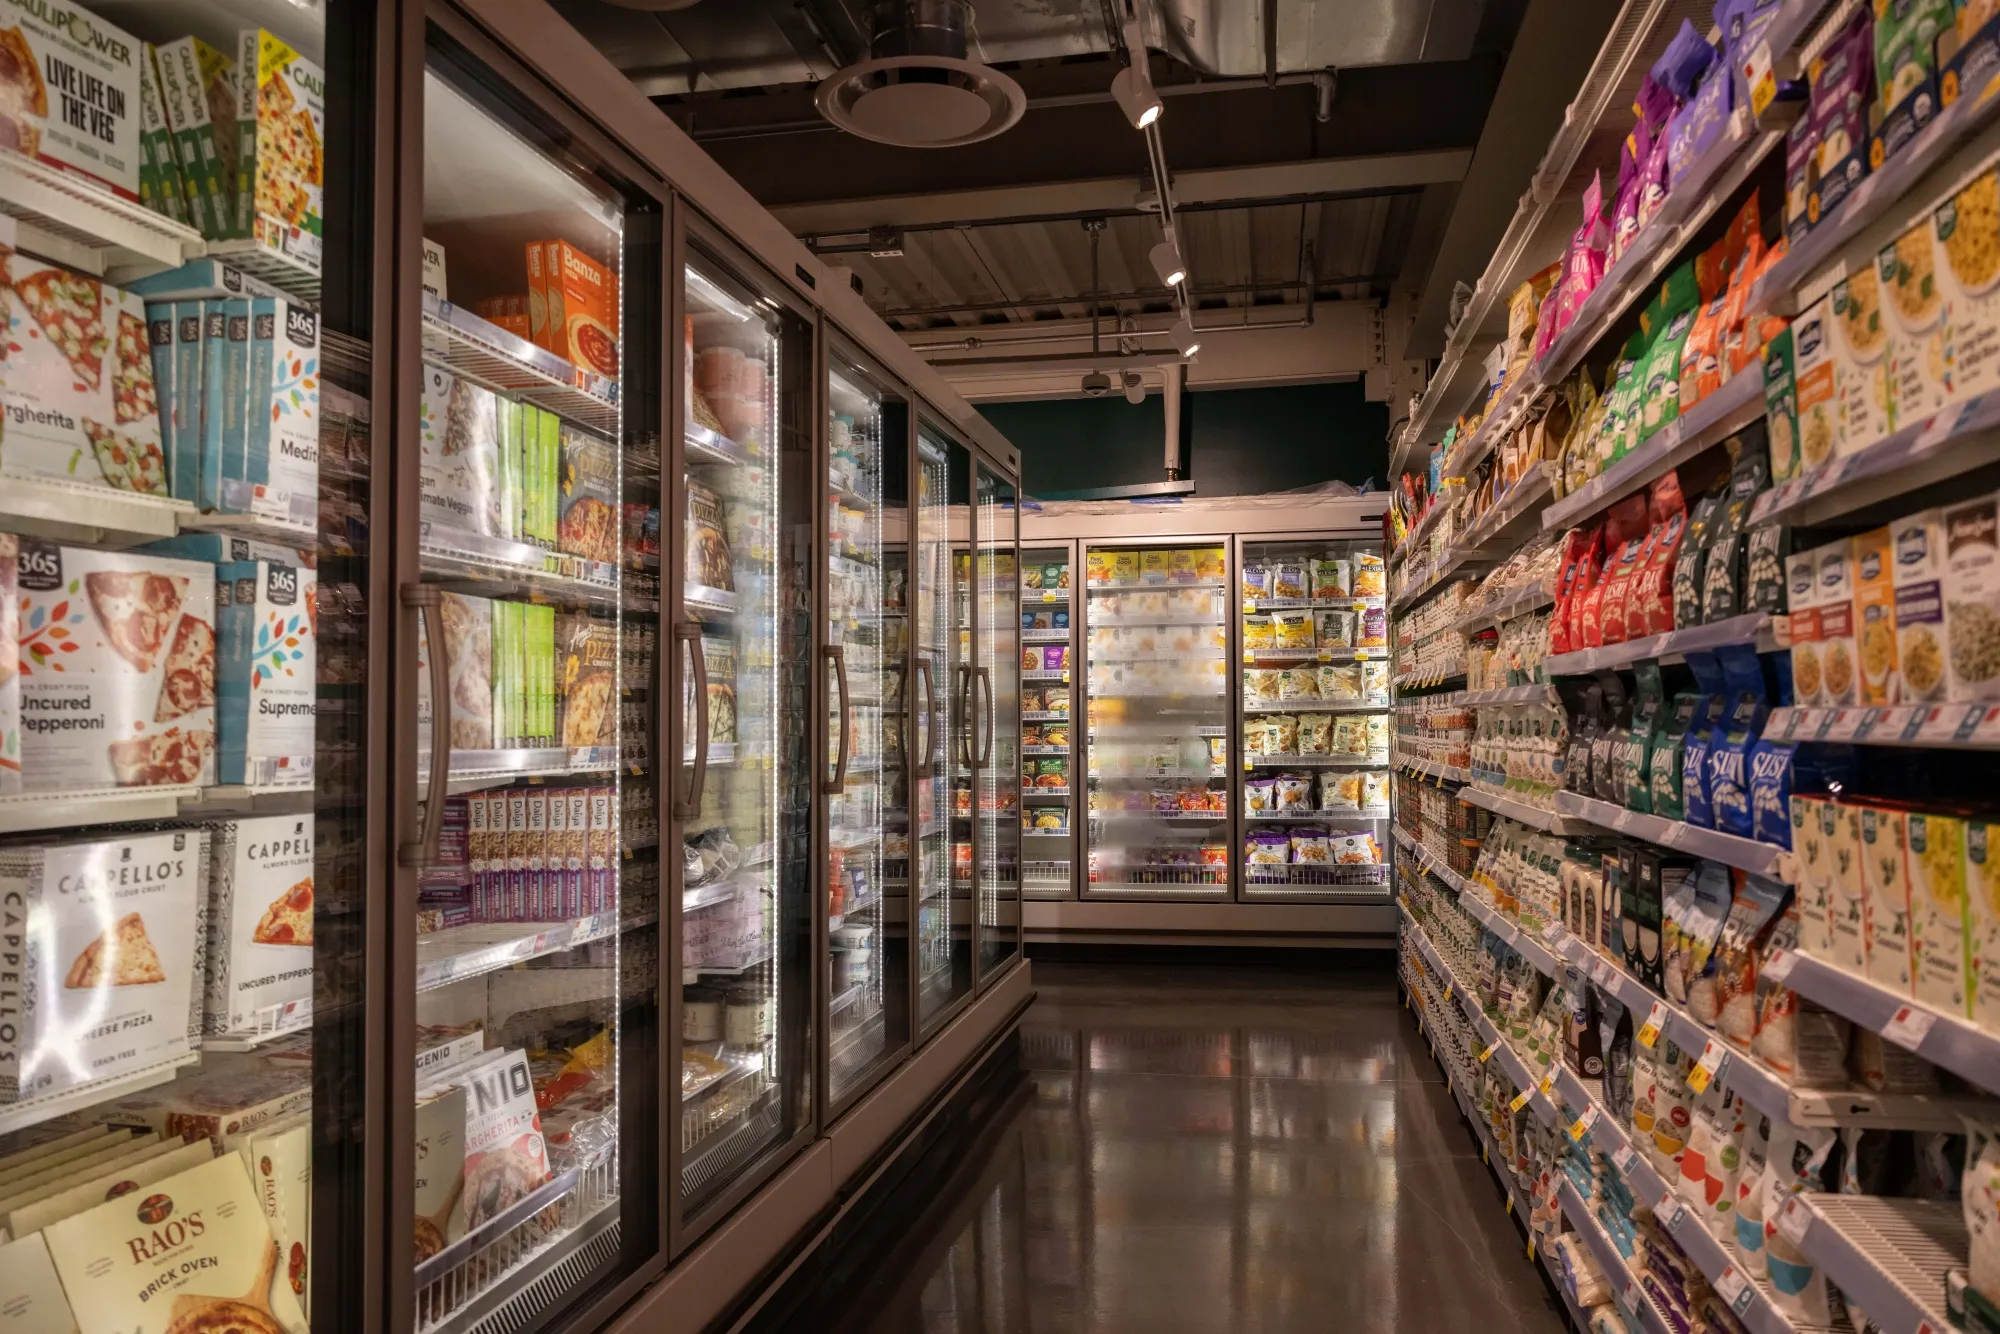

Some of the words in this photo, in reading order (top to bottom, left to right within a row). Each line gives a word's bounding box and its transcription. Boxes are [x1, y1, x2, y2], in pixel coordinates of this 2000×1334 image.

[9, 0, 131, 67] AULIPOWER
[46, 53, 76, 95] LIVE
[79, 70, 104, 110] LIFE
[107, 84, 125, 120] ON
[60, 92, 87, 133] THE
[89, 107, 115, 146] VEG
[563, 243, 601, 286] Banza
[287, 310, 314, 336] 365
[5, 403, 75, 430] rgherita
[420, 474, 436, 488] gan
[420, 492, 446, 508] imate
[20, 552, 58, 576] 365
[269, 570, 295, 593] 365
[473, 801, 484, 829] Daiya
[493, 801, 503, 828] Daiya
[514, 801, 523, 827] Daiya
[533, 800, 543, 827] Daiya
[554, 800, 564, 827] Daiya
[571, 799, 583, 826] Daiya
[595, 799, 606, 826] Daiya
[247, 838, 311, 861] CAPPEL
[58, 860, 184, 895] CAPELLO'S
[238, 975, 276, 991] UNCURED
[126, 1210, 206, 1266] RAO'S
[138, 1268, 178, 1304] BRICK
[181, 1256, 219, 1274] OVEN
